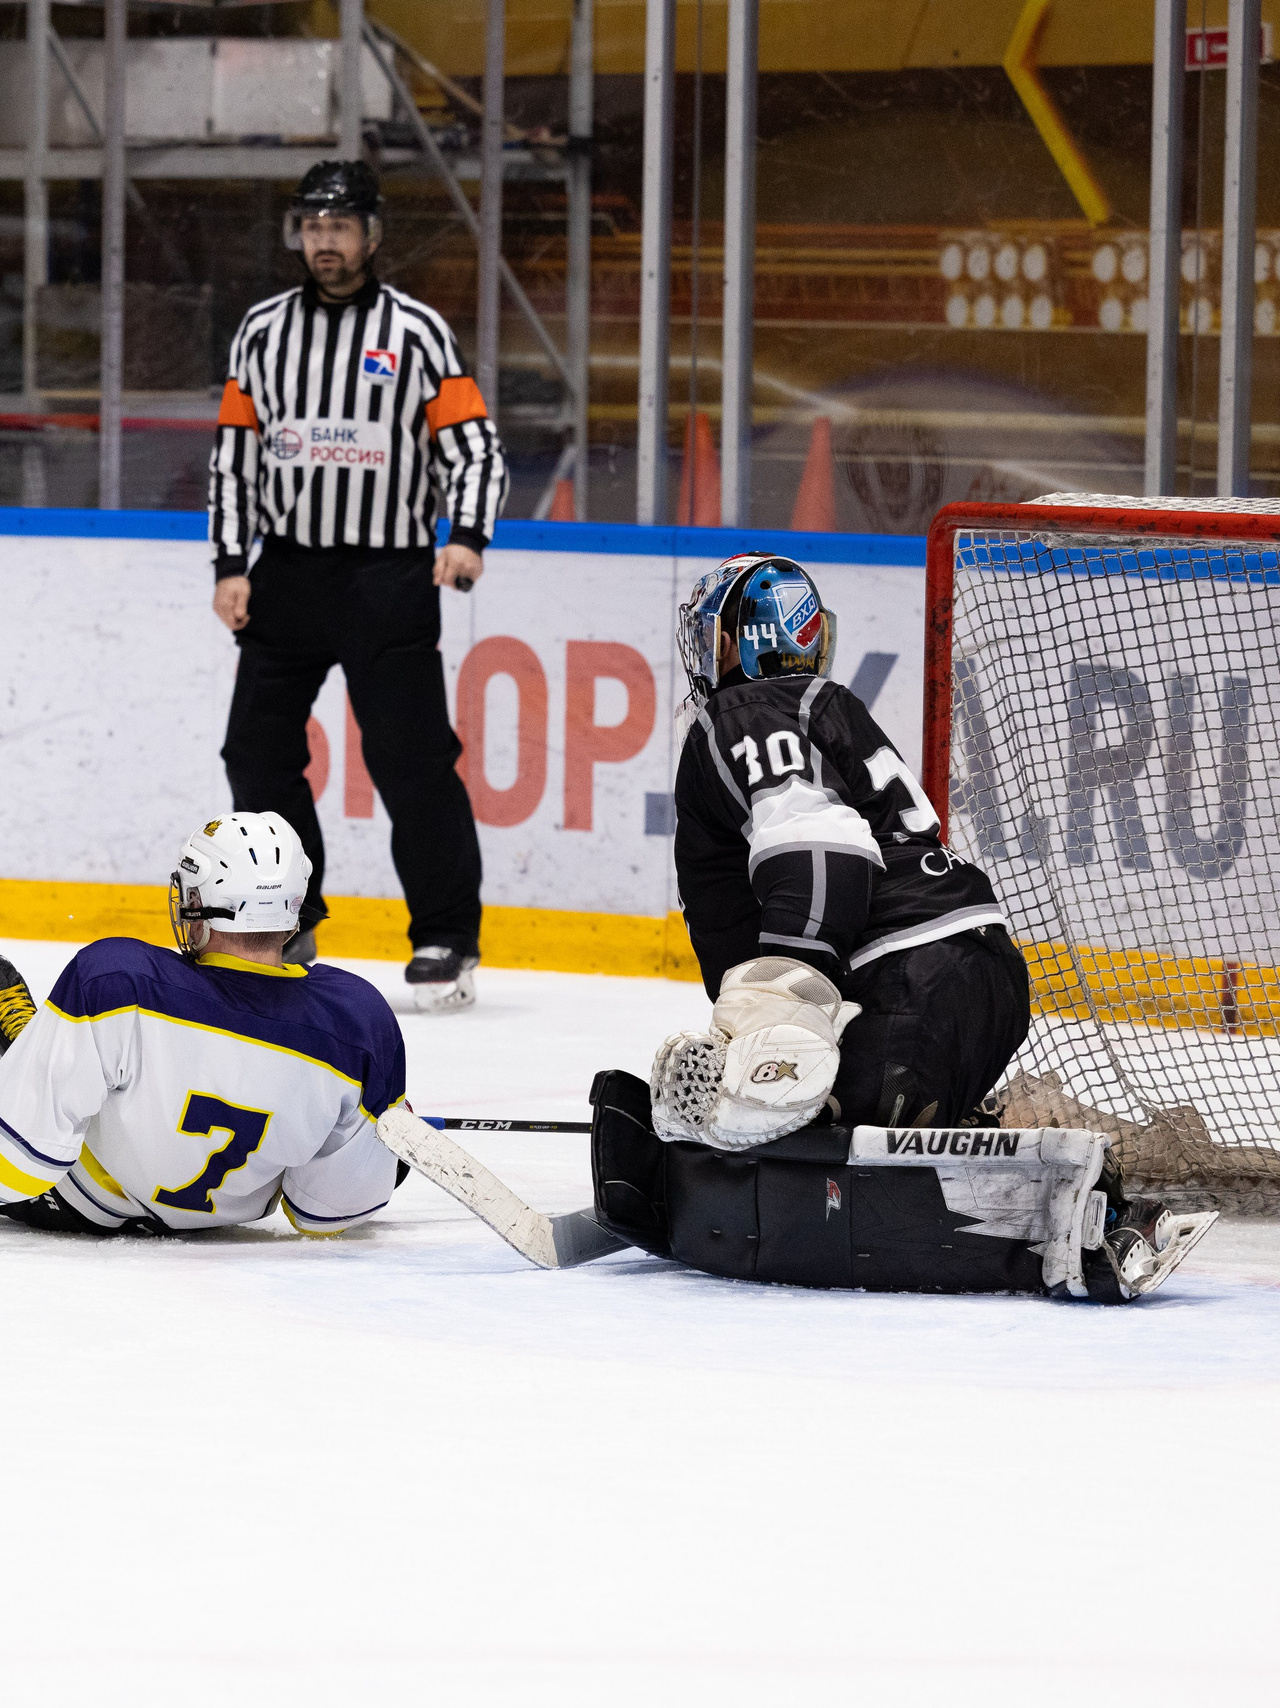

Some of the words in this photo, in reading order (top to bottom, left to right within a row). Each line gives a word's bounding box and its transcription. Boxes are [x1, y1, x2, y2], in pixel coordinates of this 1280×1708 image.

[310, 426, 358, 444] БАНК
[310, 446, 386, 465] РОССИЯ
[743, 622, 778, 651] 44
[180, 861, 199, 873] BAUER
[460, 1120, 513, 1131] CCM
[151, 1089, 274, 1214] 7
[886, 1130, 1020, 1157] VAUGHN
